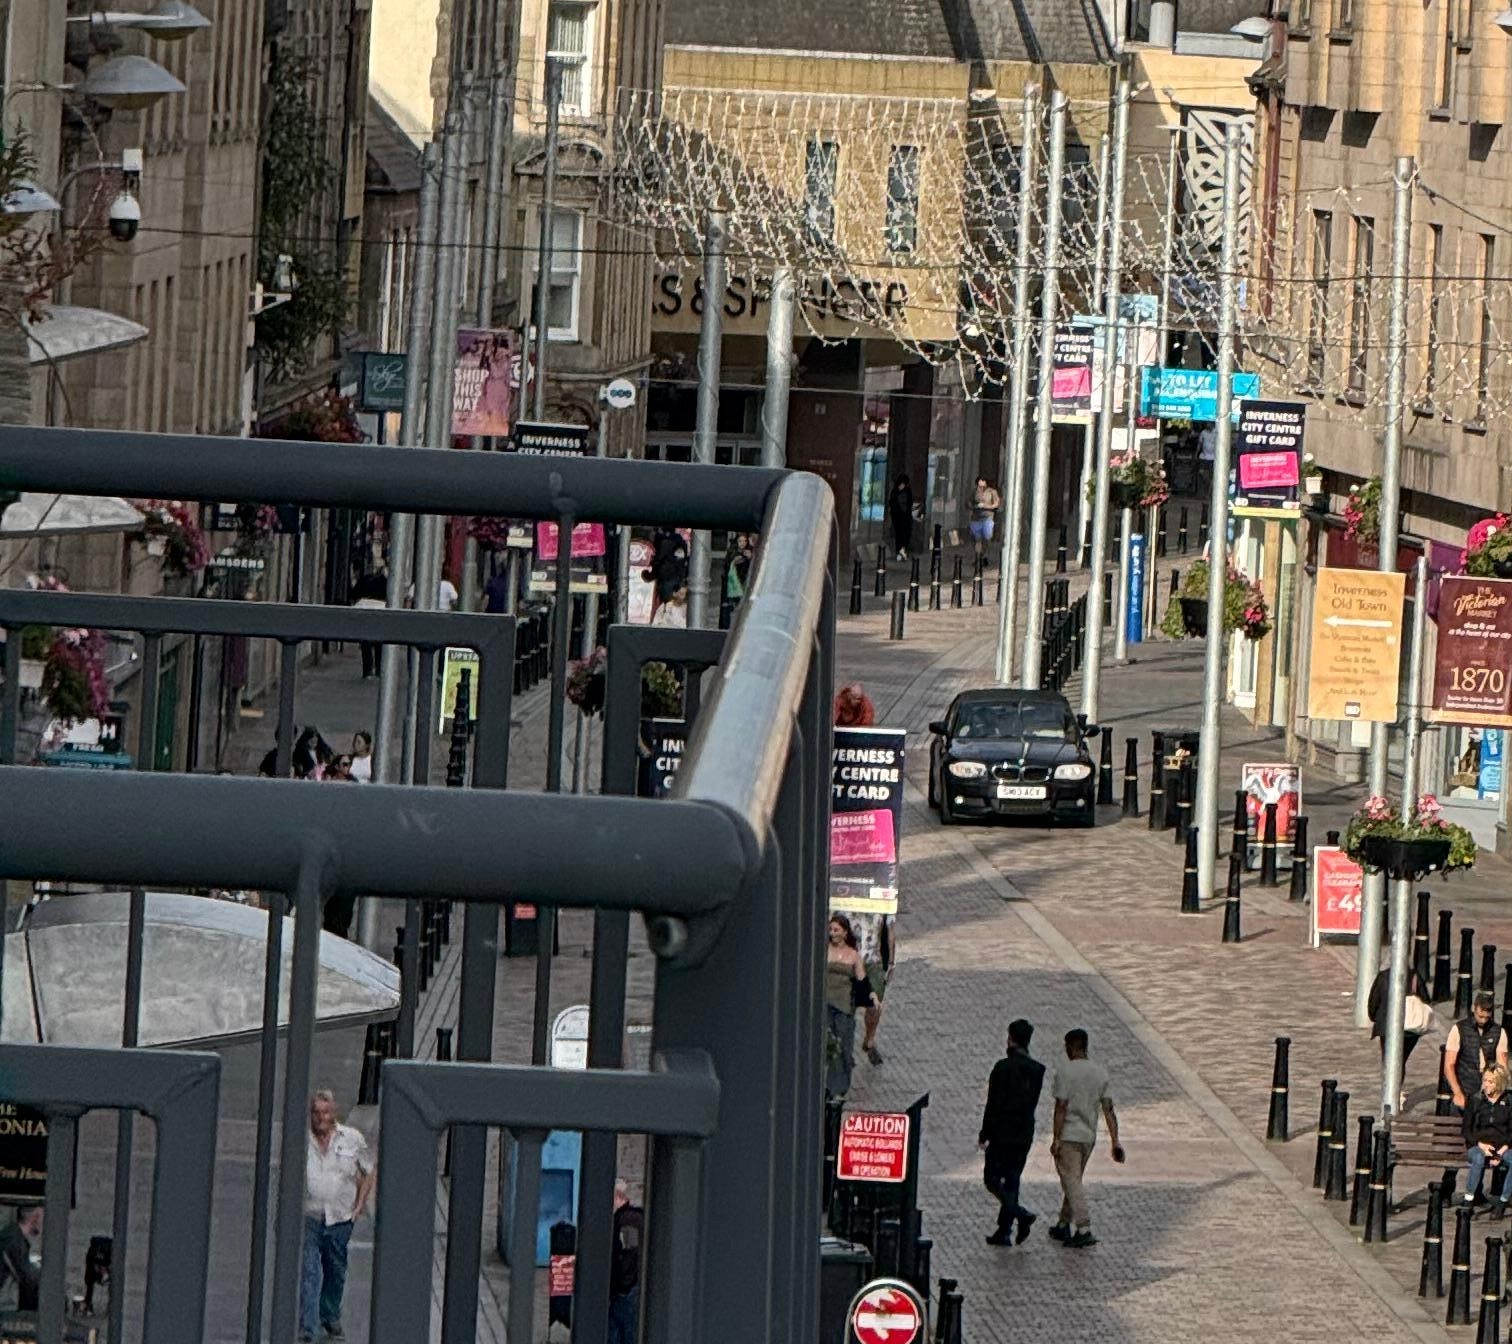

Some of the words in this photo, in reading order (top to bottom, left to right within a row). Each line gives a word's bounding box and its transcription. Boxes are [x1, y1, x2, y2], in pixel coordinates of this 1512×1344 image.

[723, 274, 909, 323] SPNCER
[453, 397, 479, 411] WAY
[1245, 410, 1300, 423] INVERNESS
[1241, 422, 1264, 432] CITY
[1264, 423, 1302, 435] CENTRE
[521, 434, 582, 449] INVERNESS
[1245, 434, 1268, 445] GIFT
[1268, 435, 1296, 447] CARD
[208, 557, 265, 569] AMSDENS
[1332, 583, 1388, 598] Inverness
[1331, 597, 1353, 610] Old
[1356, 599, 1387, 613] Town
[1453, 592, 1507, 617] Victorian
[1450, 666, 1505, 693] 1870
[656, 757, 682, 771] CIT
[832, 748, 895, 765] VERNESS
[840, 768, 899, 783] CENTRE
[847, 785, 890, 801] CARD
[831, 813, 875, 827] VERNESS
[844, 1116, 905, 1134] CAUTION
